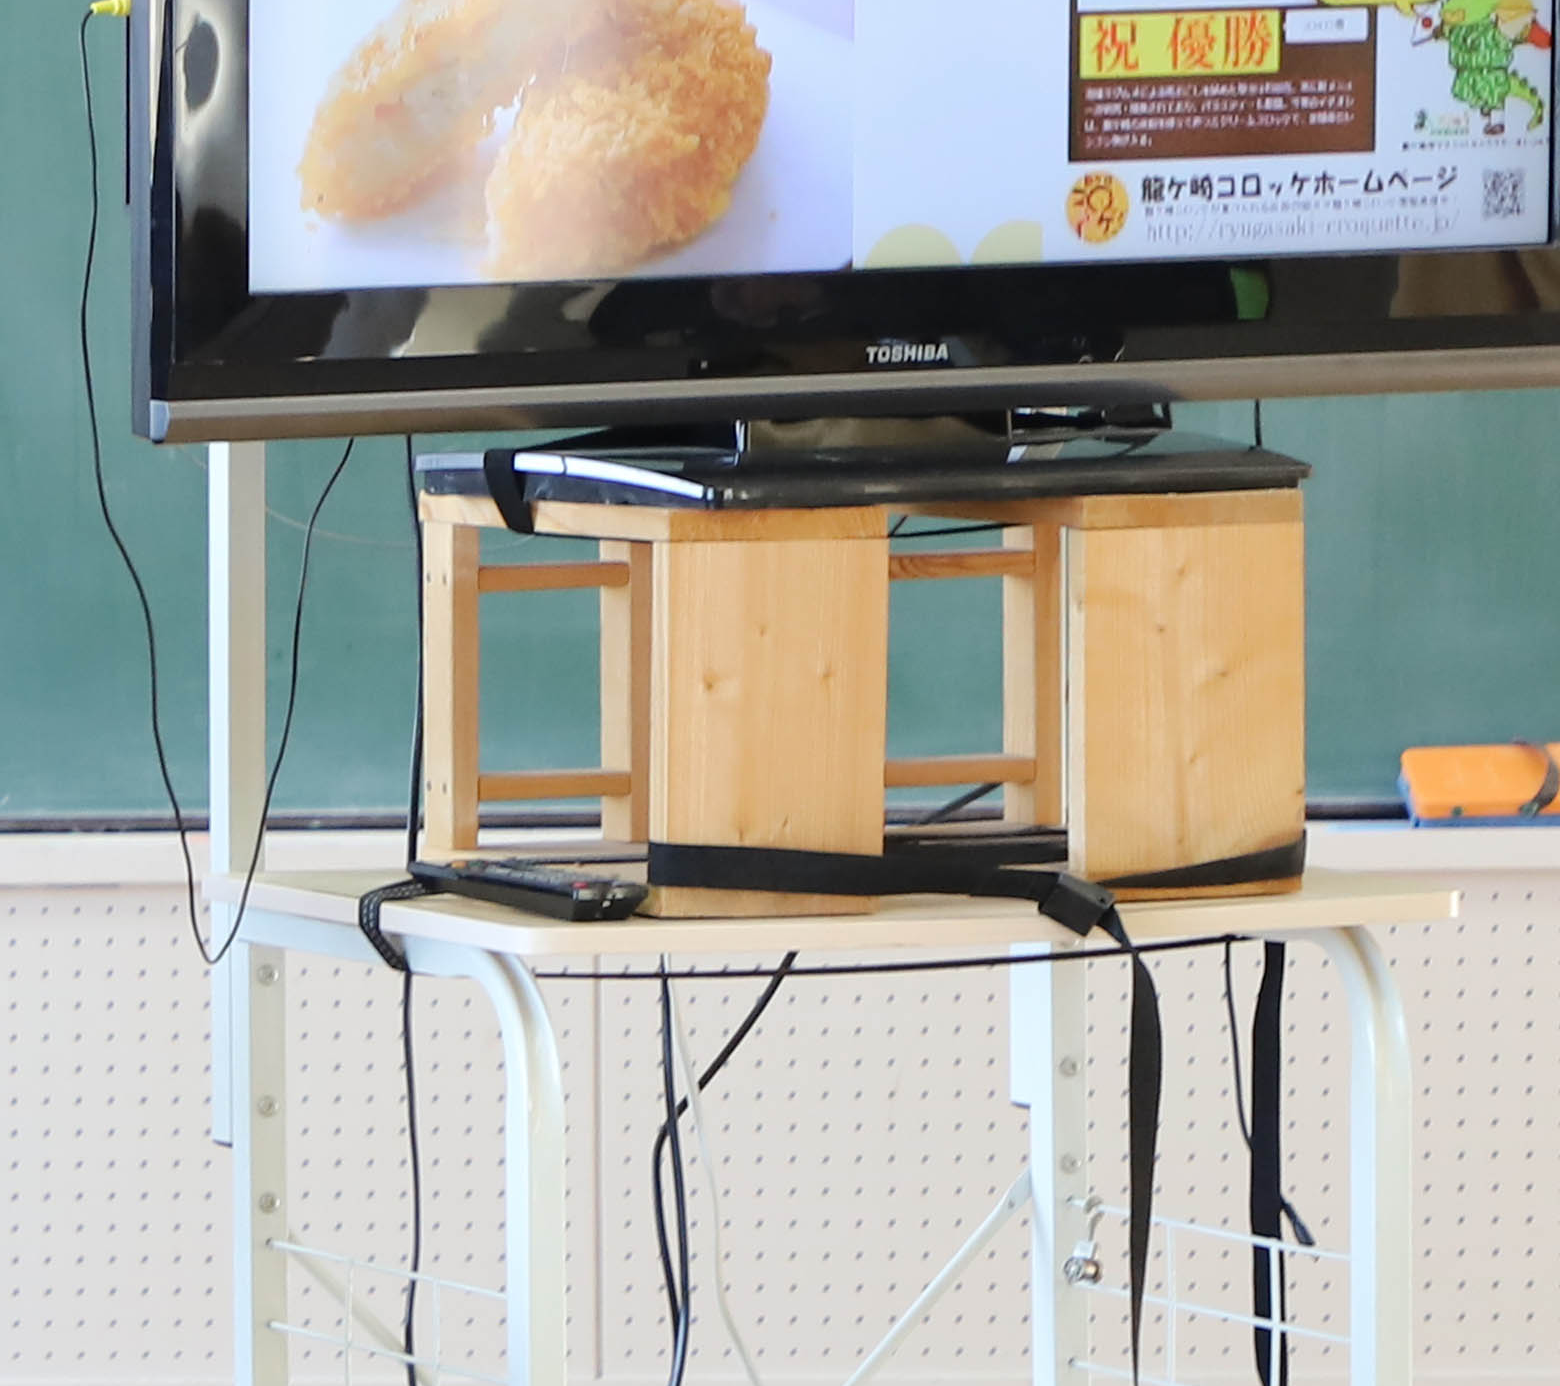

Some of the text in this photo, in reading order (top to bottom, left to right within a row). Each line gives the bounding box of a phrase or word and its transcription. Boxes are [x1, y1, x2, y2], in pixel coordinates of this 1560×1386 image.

[1092, 12, 1272, 73] 祝 優勝
[866, 343, 948, 363] TOSHIBA
